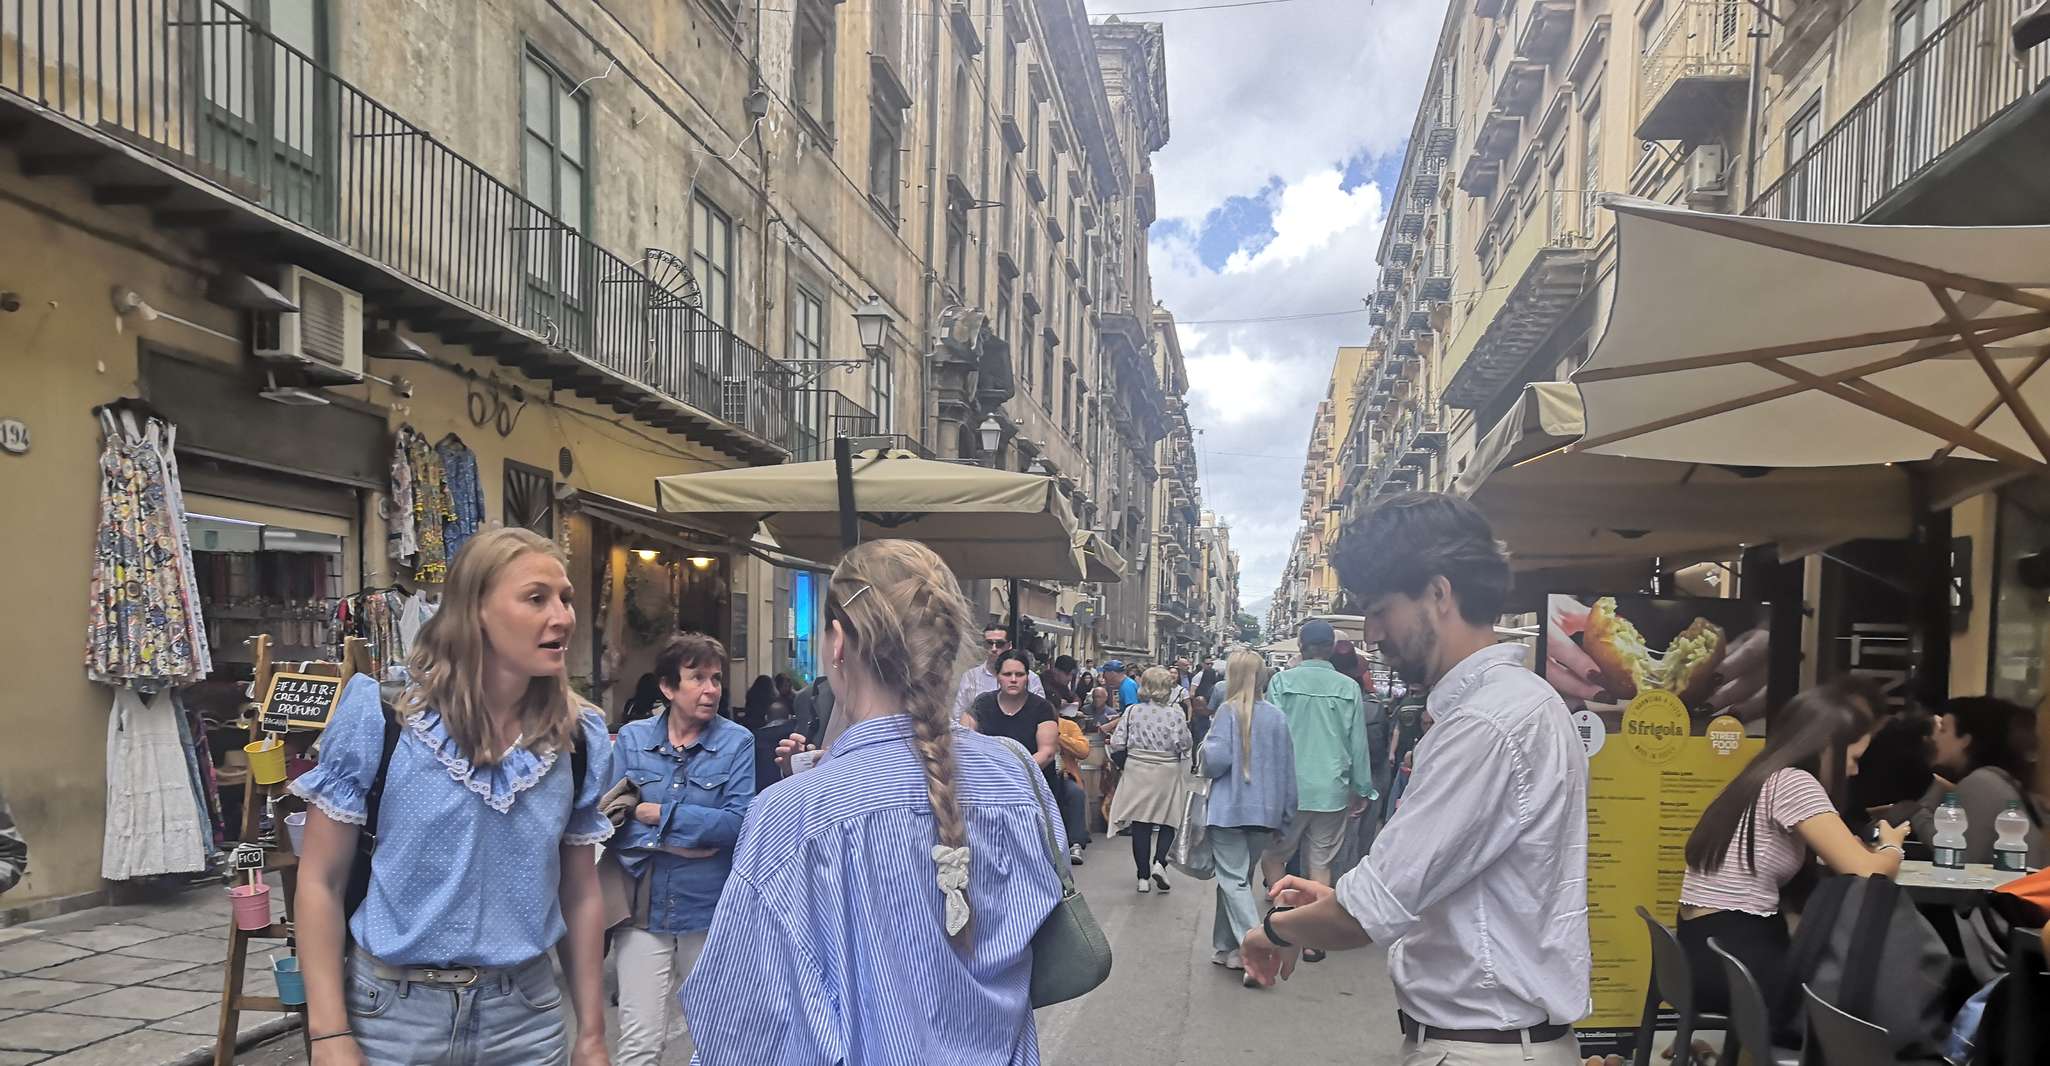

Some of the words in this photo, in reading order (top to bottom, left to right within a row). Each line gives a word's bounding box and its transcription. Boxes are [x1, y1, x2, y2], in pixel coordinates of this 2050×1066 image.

[2, 424, 29, 446] 194
[279, 681, 329, 695] FLAIR
[273, 692, 300, 702] CREA
[1628, 720, 1684, 740] Sfrigola
[1710, 731, 1742, 741] STREET
[1712, 740, 1739, 750] FOOD
[238, 851, 261, 863] FICO
